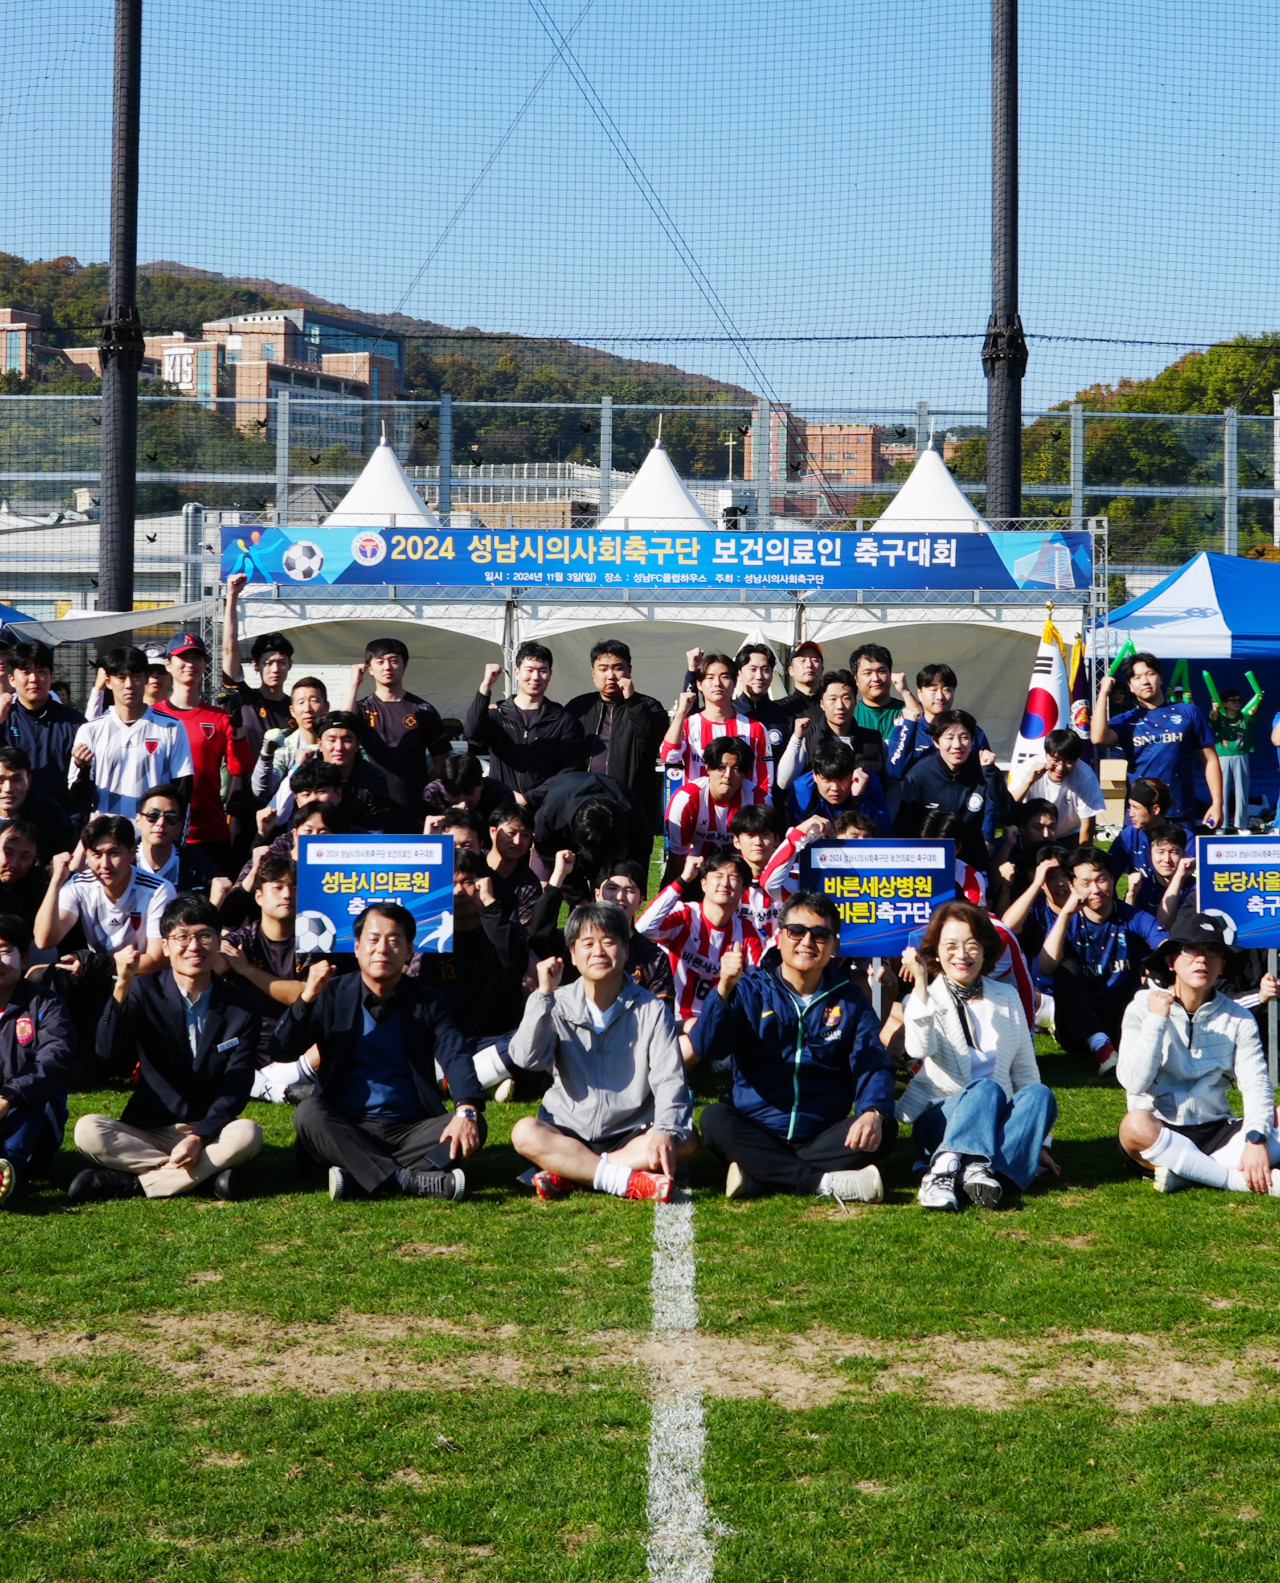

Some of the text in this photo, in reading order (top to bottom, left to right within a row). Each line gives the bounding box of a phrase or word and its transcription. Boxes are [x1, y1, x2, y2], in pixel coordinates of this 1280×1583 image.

[164, 354, 193, 383] KIS
[390, 535, 456, 560] 2024
[467, 536, 700, 565] 성남시의사회축구단
[712, 537, 841, 567] 보건의료인
[854, 538, 957, 567] 축구대회
[484, 571, 503, 581] 일시
[513, 572, 543, 581] 2024년
[546, 572, 564, 582] 11월
[566, 572, 597, 582] 3일(일)
[604, 573, 622, 583] 장소
[633, 573, 708, 583] 성남FC클럽하우스
[715, 574, 733, 583] 주최
[743, 574, 824, 584] 성남시의사회축구단
[1132, 732, 1183, 747] SNUBH
[321, 871, 430, 894] 성남시의료원
[824, 875, 933, 898] 바른세상병원
